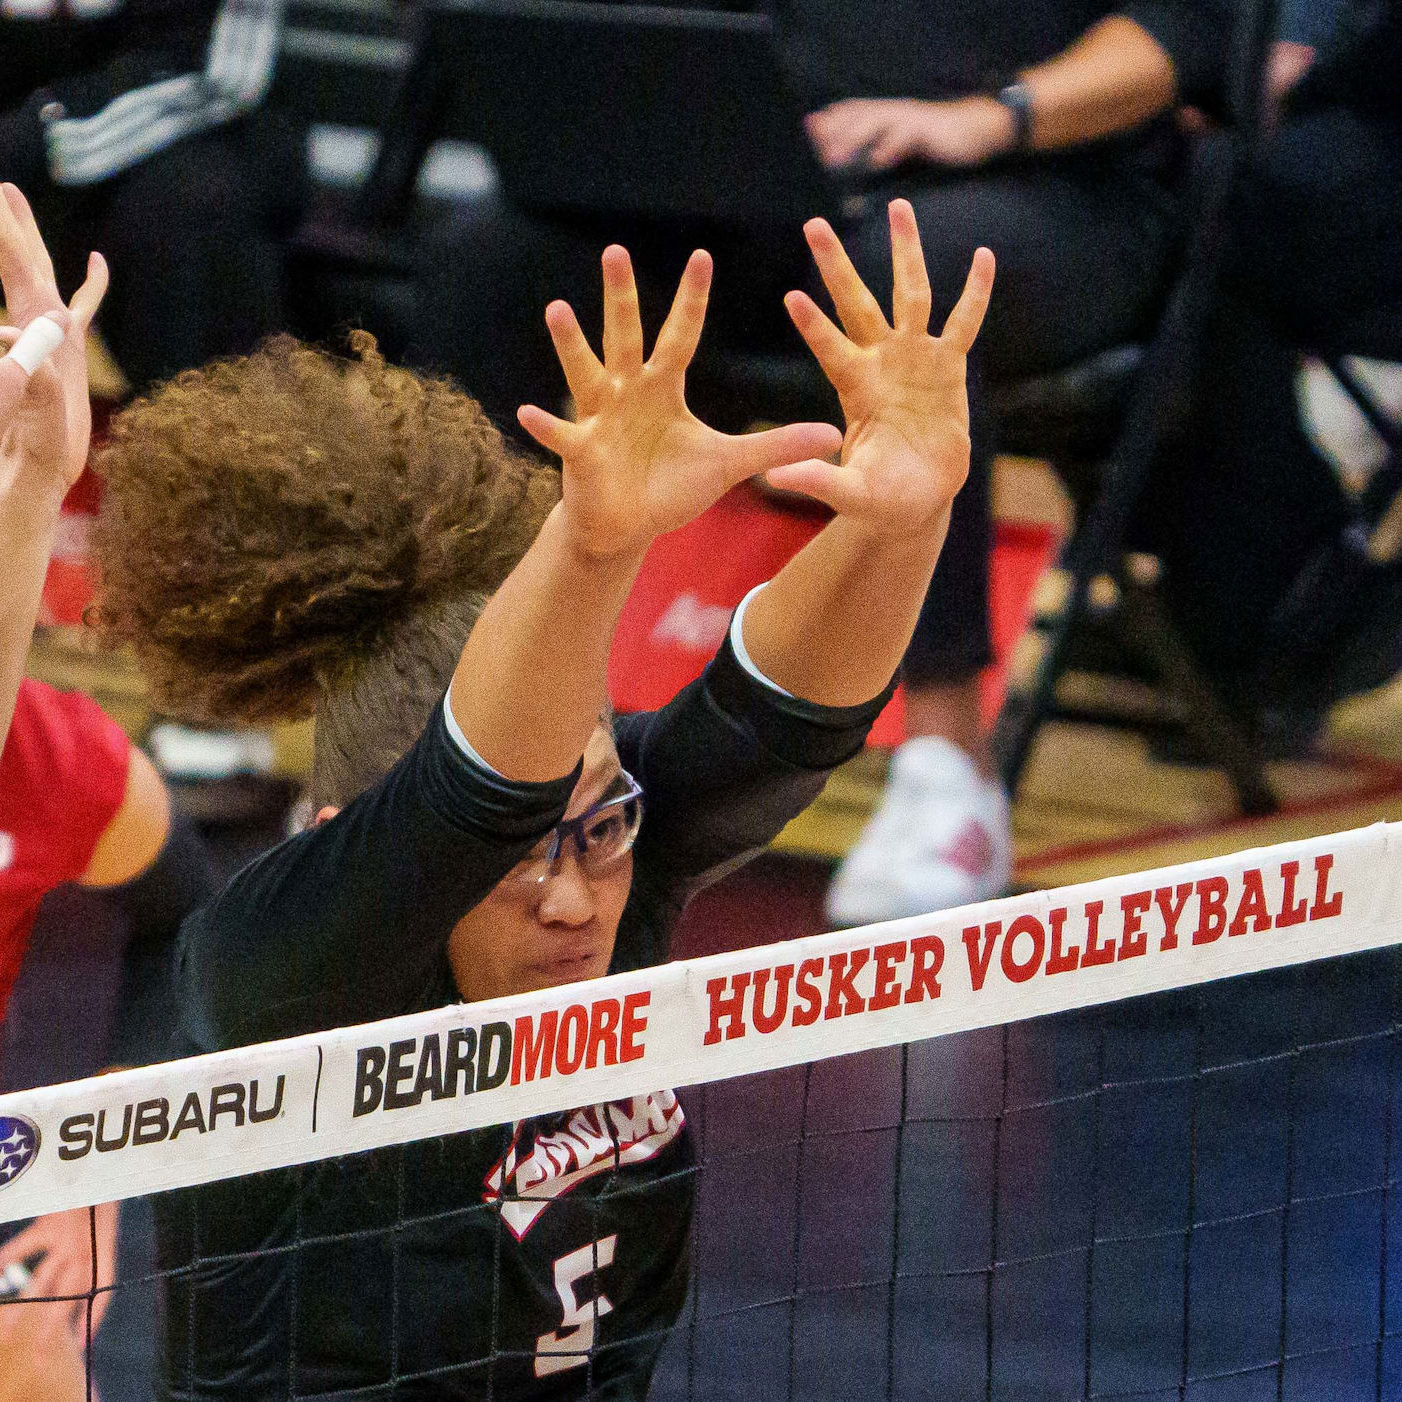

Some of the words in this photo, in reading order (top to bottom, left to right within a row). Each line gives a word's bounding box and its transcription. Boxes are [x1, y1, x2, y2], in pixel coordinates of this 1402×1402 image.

[703, 935, 945, 1046] HUSKER
[961, 853, 1344, 991] VOLLEYBALL
[58, 1074, 287, 1161] SUBARU
[353, 991, 651, 1118] BEARDMORE
[534, 1234, 618, 1379] 5
